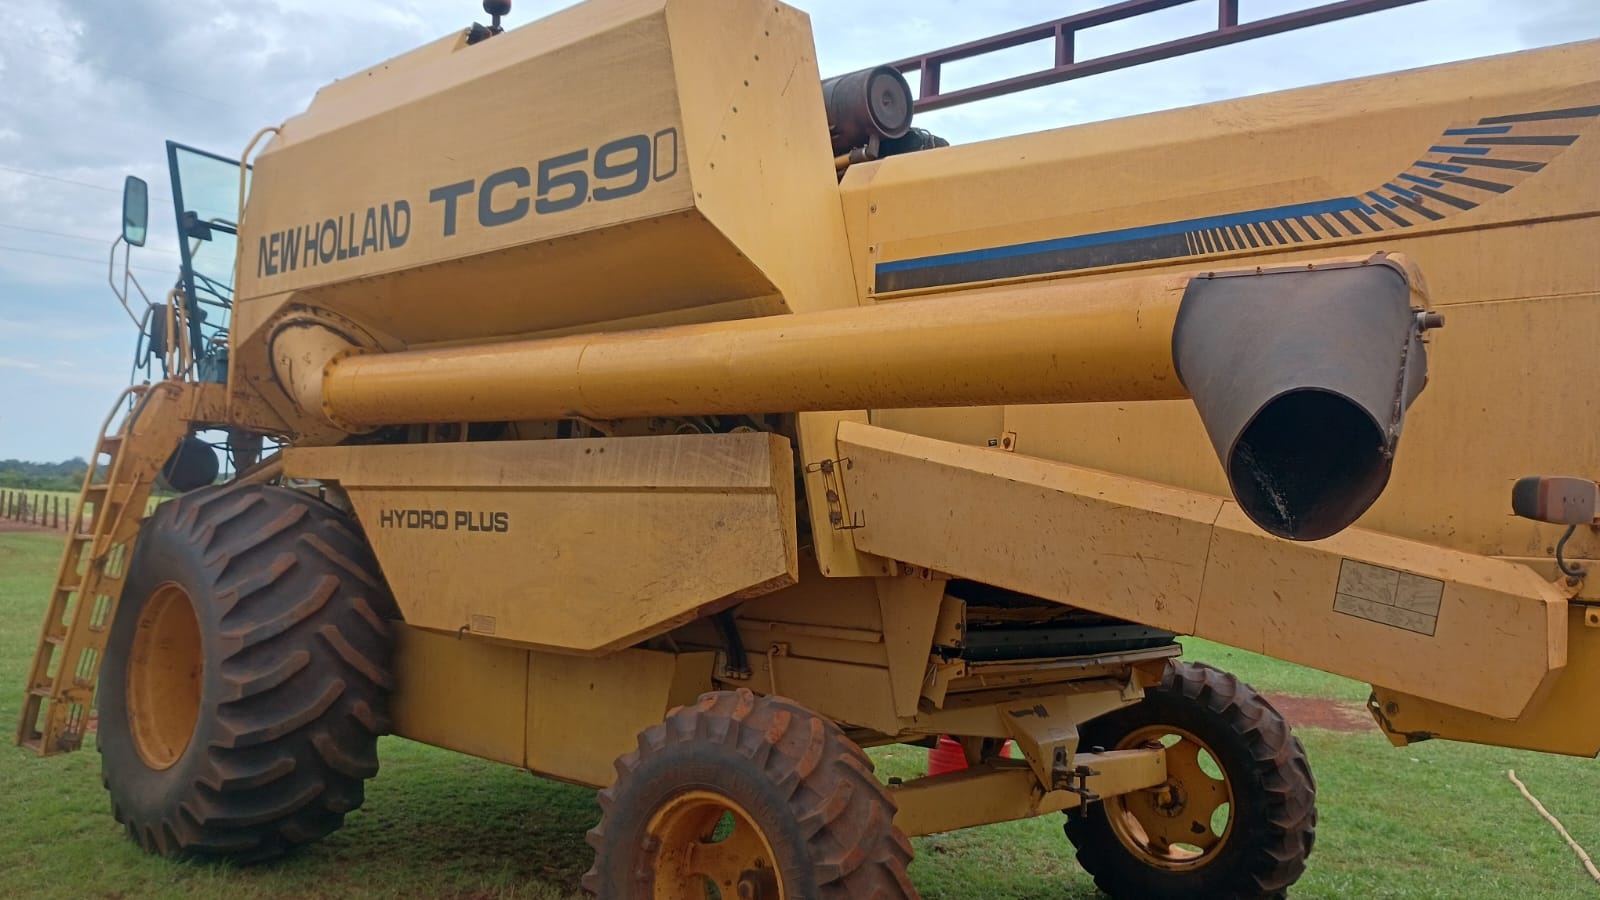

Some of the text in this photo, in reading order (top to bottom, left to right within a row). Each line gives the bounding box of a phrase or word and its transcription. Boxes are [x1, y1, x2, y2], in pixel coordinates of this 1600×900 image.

[257, 199, 411, 279] NEW HOLLAND
[380, 509, 509, 532] HYDRO PLUS
